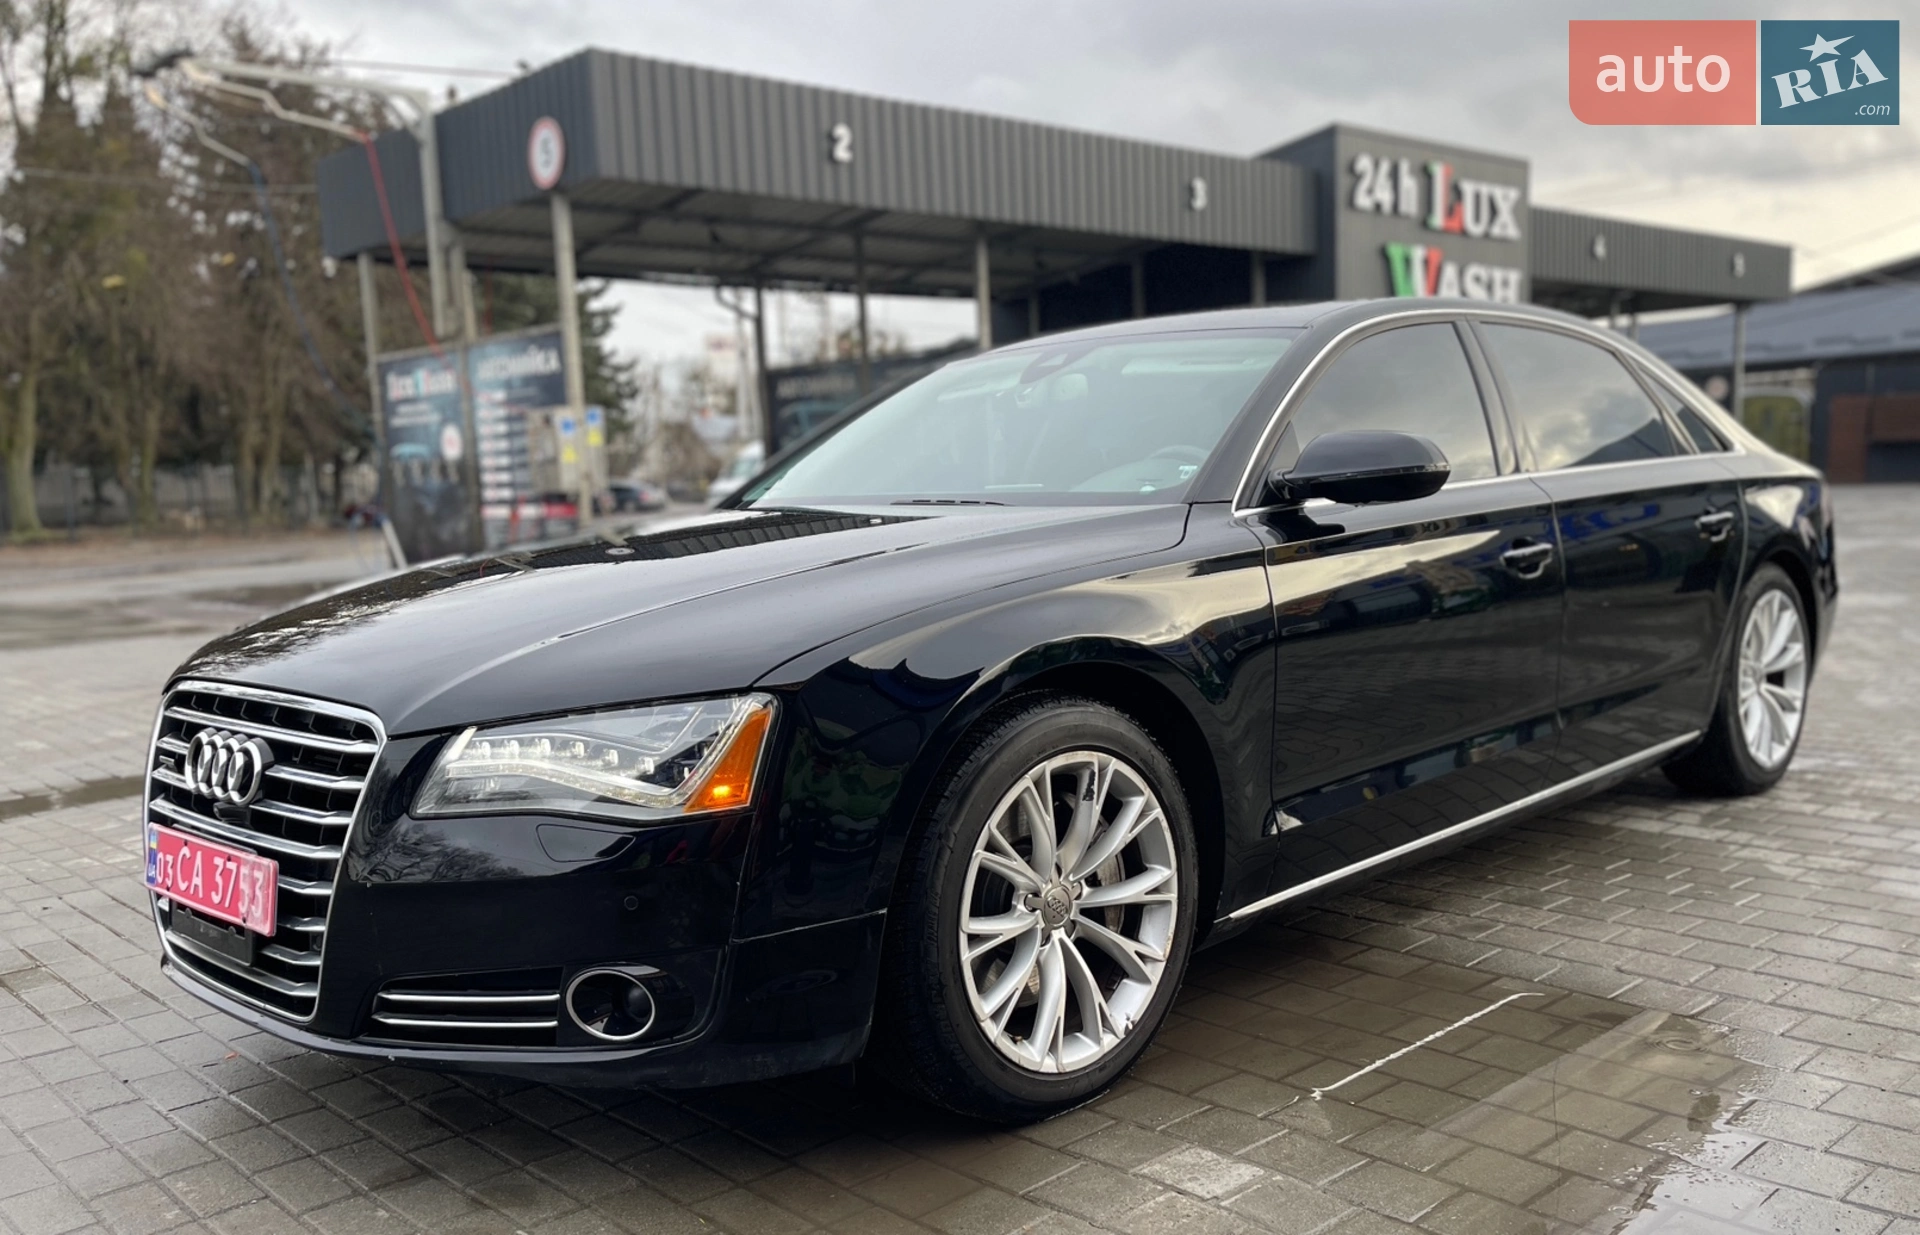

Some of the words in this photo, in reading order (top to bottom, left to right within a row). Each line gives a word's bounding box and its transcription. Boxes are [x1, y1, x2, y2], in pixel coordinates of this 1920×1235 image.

[831, 122, 853, 163] 2
[1353, 153, 1419, 217] 24h
[1385, 241, 1523, 304] WASH
[156, 851, 174, 888] 03
[210, 856, 264, 918] 3753
